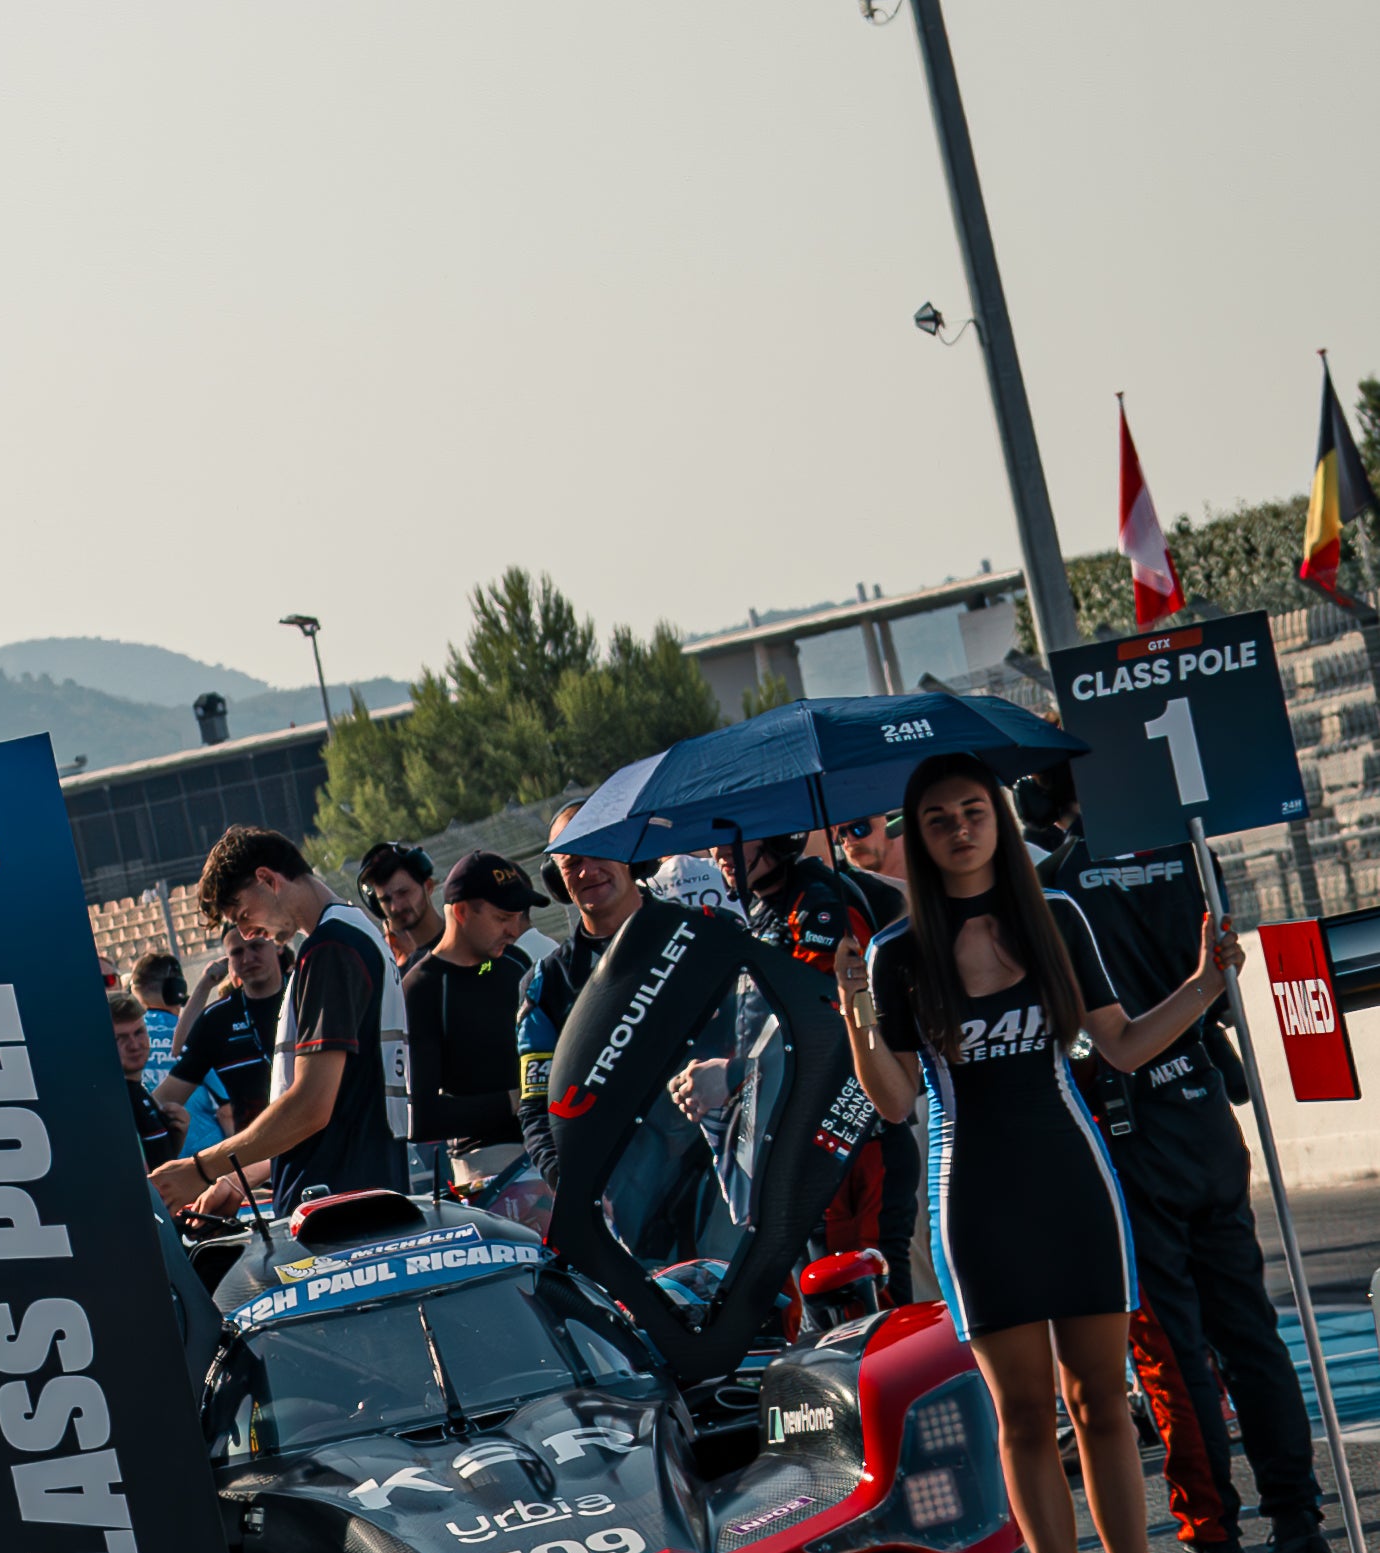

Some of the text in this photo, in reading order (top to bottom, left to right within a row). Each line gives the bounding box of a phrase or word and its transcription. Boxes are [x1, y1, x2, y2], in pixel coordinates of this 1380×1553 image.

[1147, 638, 1171, 652] GTX
[1071, 640, 1257, 701] CLASS POLE
[881, 718, 932, 737] 24H
[1144, 697, 1209, 806] 1
[1079, 860, 1184, 891] GRAFF
[584, 921, 696, 1087] TROUILLET
[830, 1076, 859, 1116] PAGE
[350, 1227, 475, 1260] MICHELIN
[234, 1244, 540, 1331] 12H PAUL RICARD
